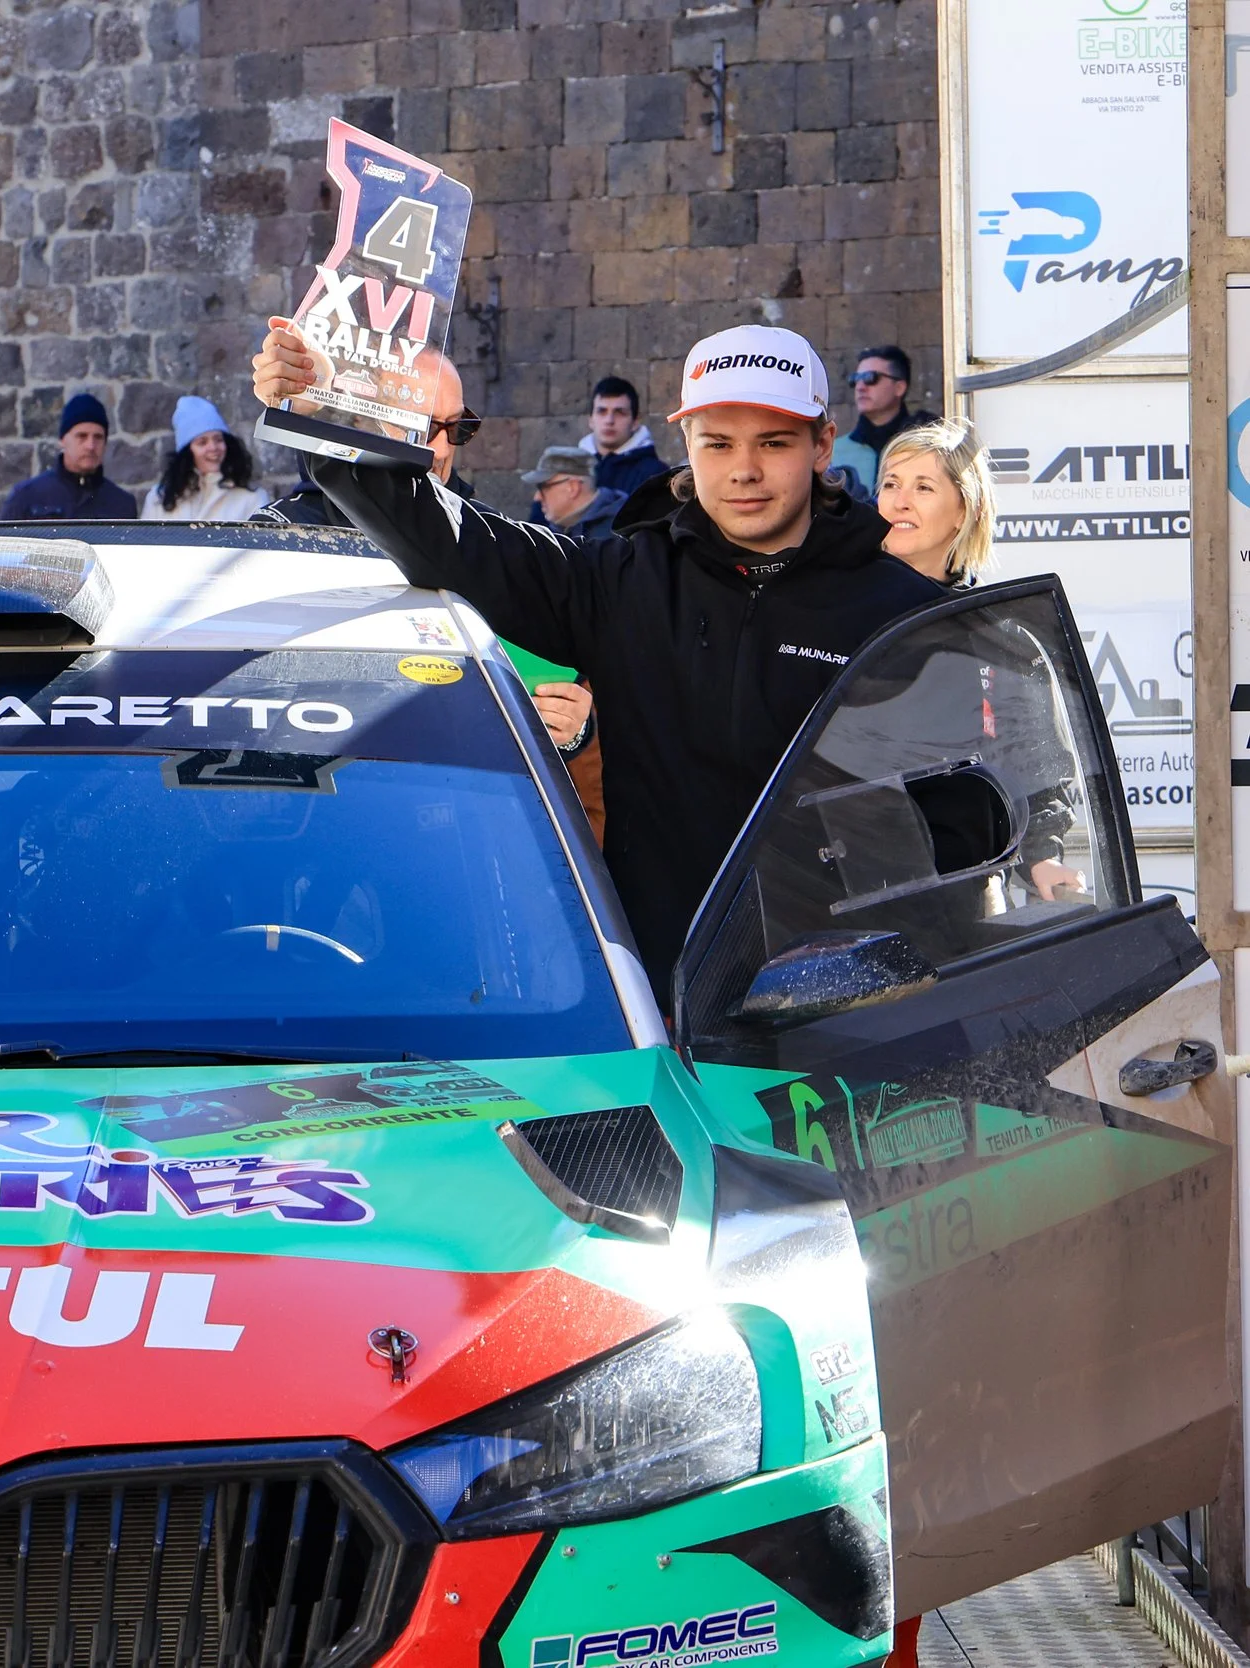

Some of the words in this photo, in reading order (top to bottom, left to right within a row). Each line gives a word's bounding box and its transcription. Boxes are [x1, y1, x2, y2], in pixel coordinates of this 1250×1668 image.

[1081, 63, 1135, 75] VENDITA
[362, 195, 438, 285] 4
[315, 264, 435, 348] XVI
[304, 313, 427, 368] RALLY
[369, 358, 420, 379] D'ORCIA
[335, 393, 370, 408] ITALIANO
[371, 403, 393, 414] RALLY
[1032, 487, 1103, 501] MACCHINE
[1106, 487, 1114, 499] E
[1117, 485, 1175, 498] UTENSILI
[778, 643, 797, 655] MS
[266, 1083, 316, 1101] 6
[232, 1107, 479, 1143] CONCORRENTE
[985, 1124, 1034, 1154] TENUTA
[575, 1602, 777, 1667] FOMEC
[674, 1640, 778, 1667] COMPONENTS
